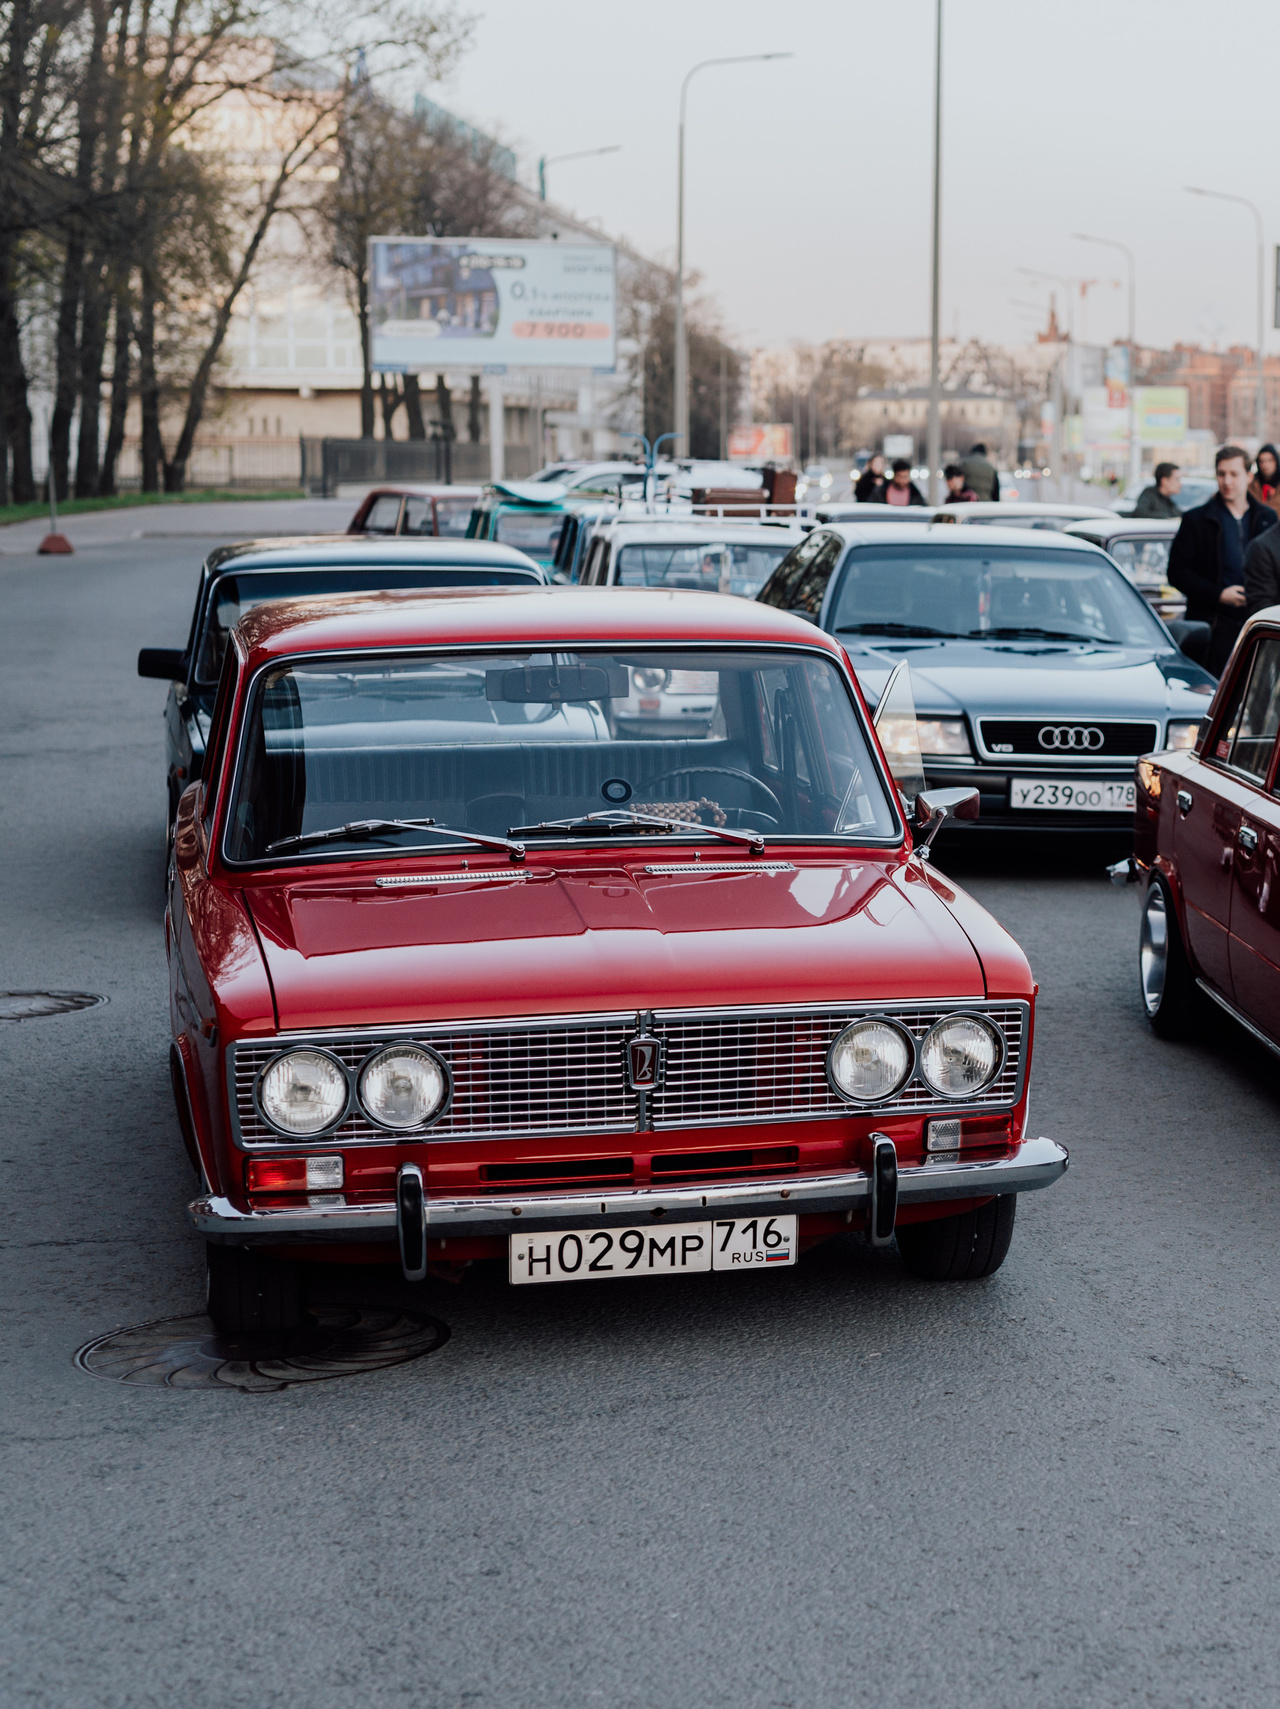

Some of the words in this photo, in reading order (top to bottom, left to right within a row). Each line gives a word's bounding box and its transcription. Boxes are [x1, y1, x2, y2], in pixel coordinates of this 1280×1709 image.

[1106, 785, 1135, 802] 178
[715, 1217, 784, 1253] 716
[731, 1250, 765, 1264] RUS
